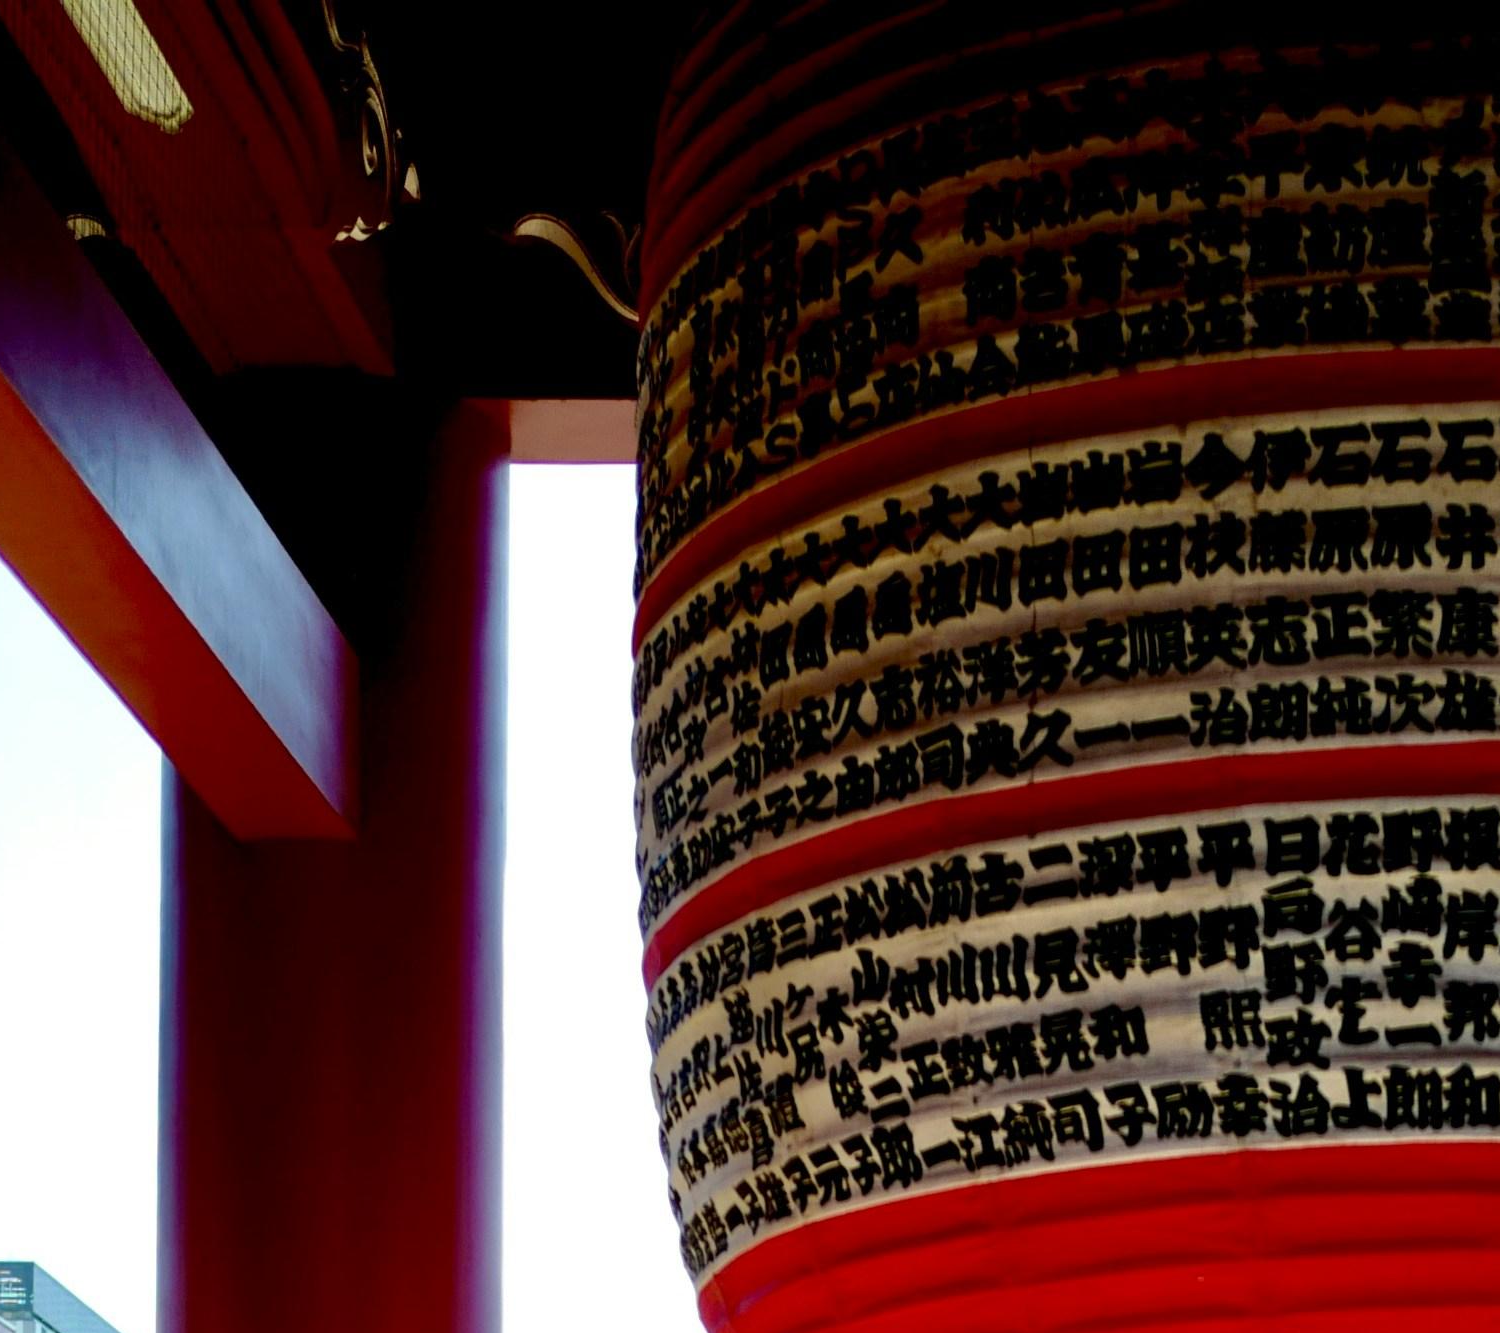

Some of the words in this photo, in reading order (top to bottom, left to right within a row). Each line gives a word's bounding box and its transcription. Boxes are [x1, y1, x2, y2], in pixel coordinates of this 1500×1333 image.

[1127, 437, 1186, 744] 岩田順一
[1309, 422, 1369, 738] 石原正純
